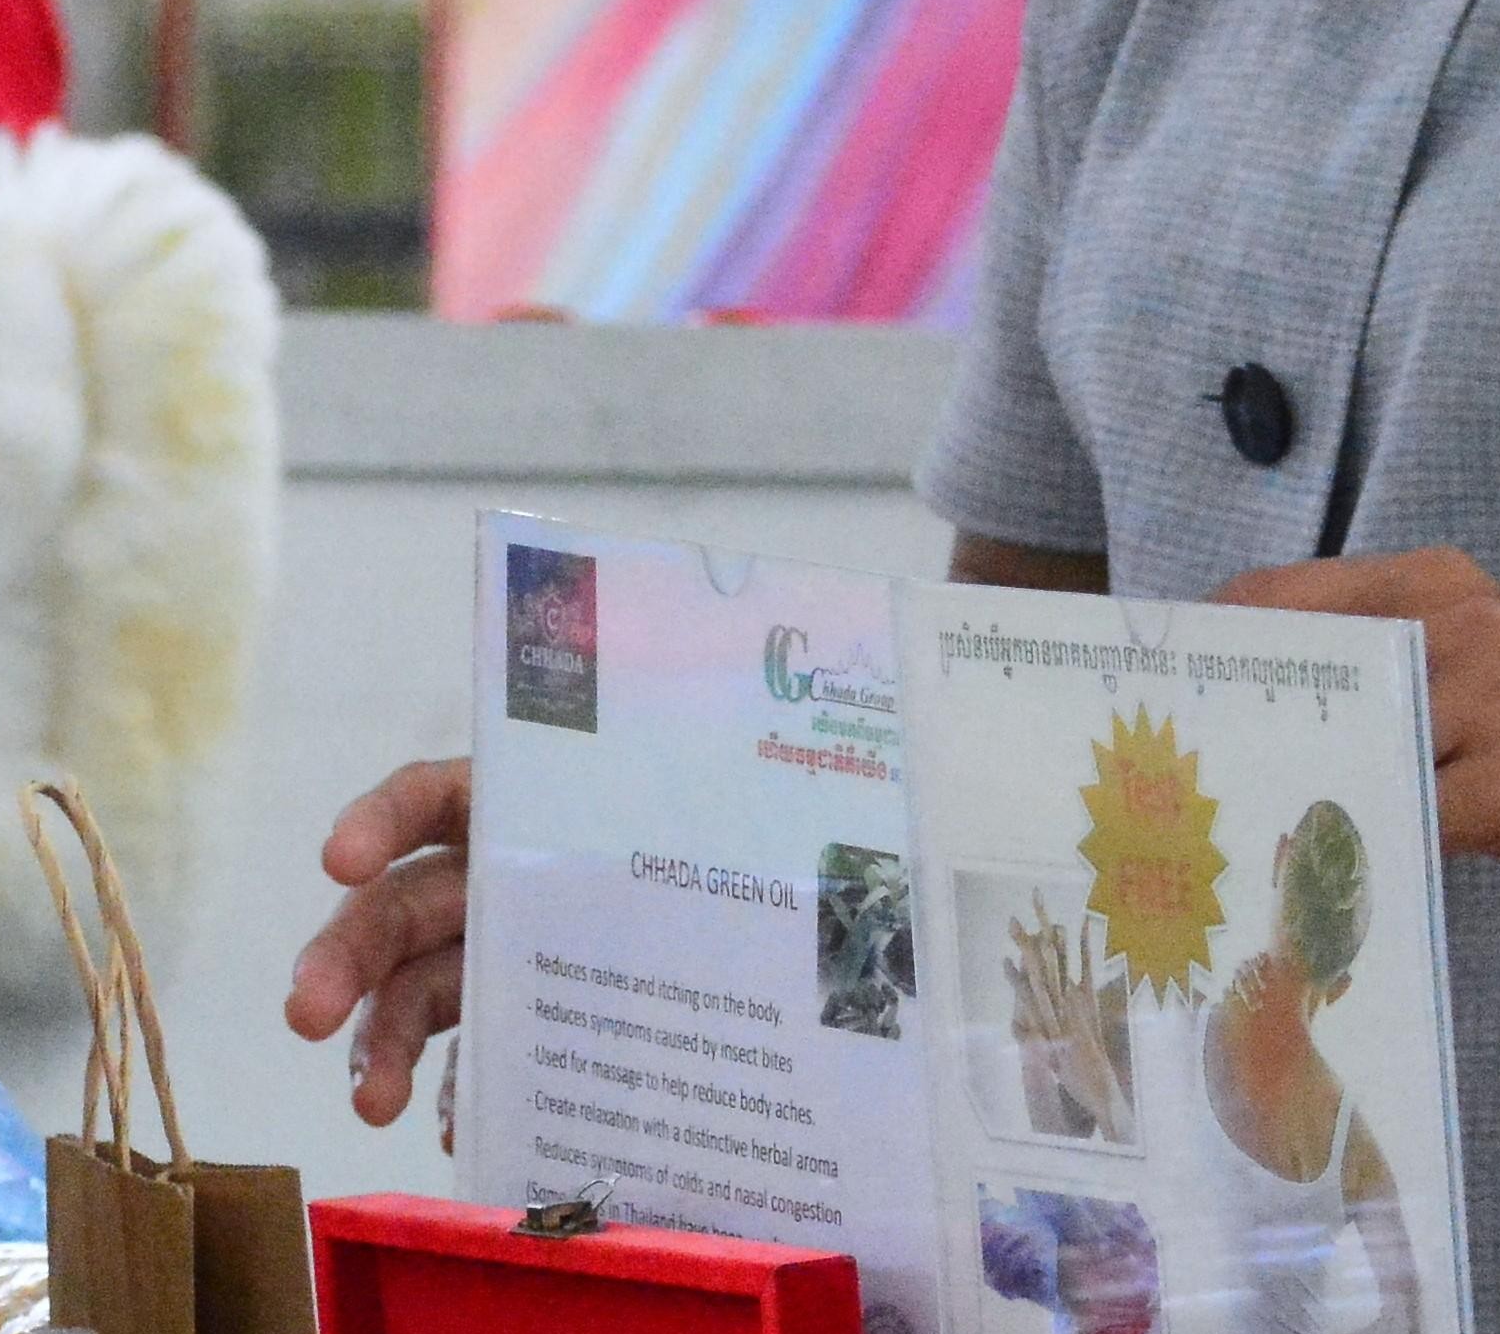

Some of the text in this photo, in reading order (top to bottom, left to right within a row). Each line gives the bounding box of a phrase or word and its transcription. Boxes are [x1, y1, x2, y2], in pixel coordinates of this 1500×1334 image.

[631, 851, 798, 910] CHHADA GREEN OIL
[535, 952, 783, 1027] Reduces rashes and itching on the body.
[535, 998, 793, 1074] Reduces symptoms caused by insect bites
[535, 1046, 816, 1126] Used for massage to help reduce body aches.
[534, 1090, 839, 1178] Create relaxation with a distinctive herbal aroma
[535, 1136, 843, 1227] Reduces symptoms of colds and nasal congestion
